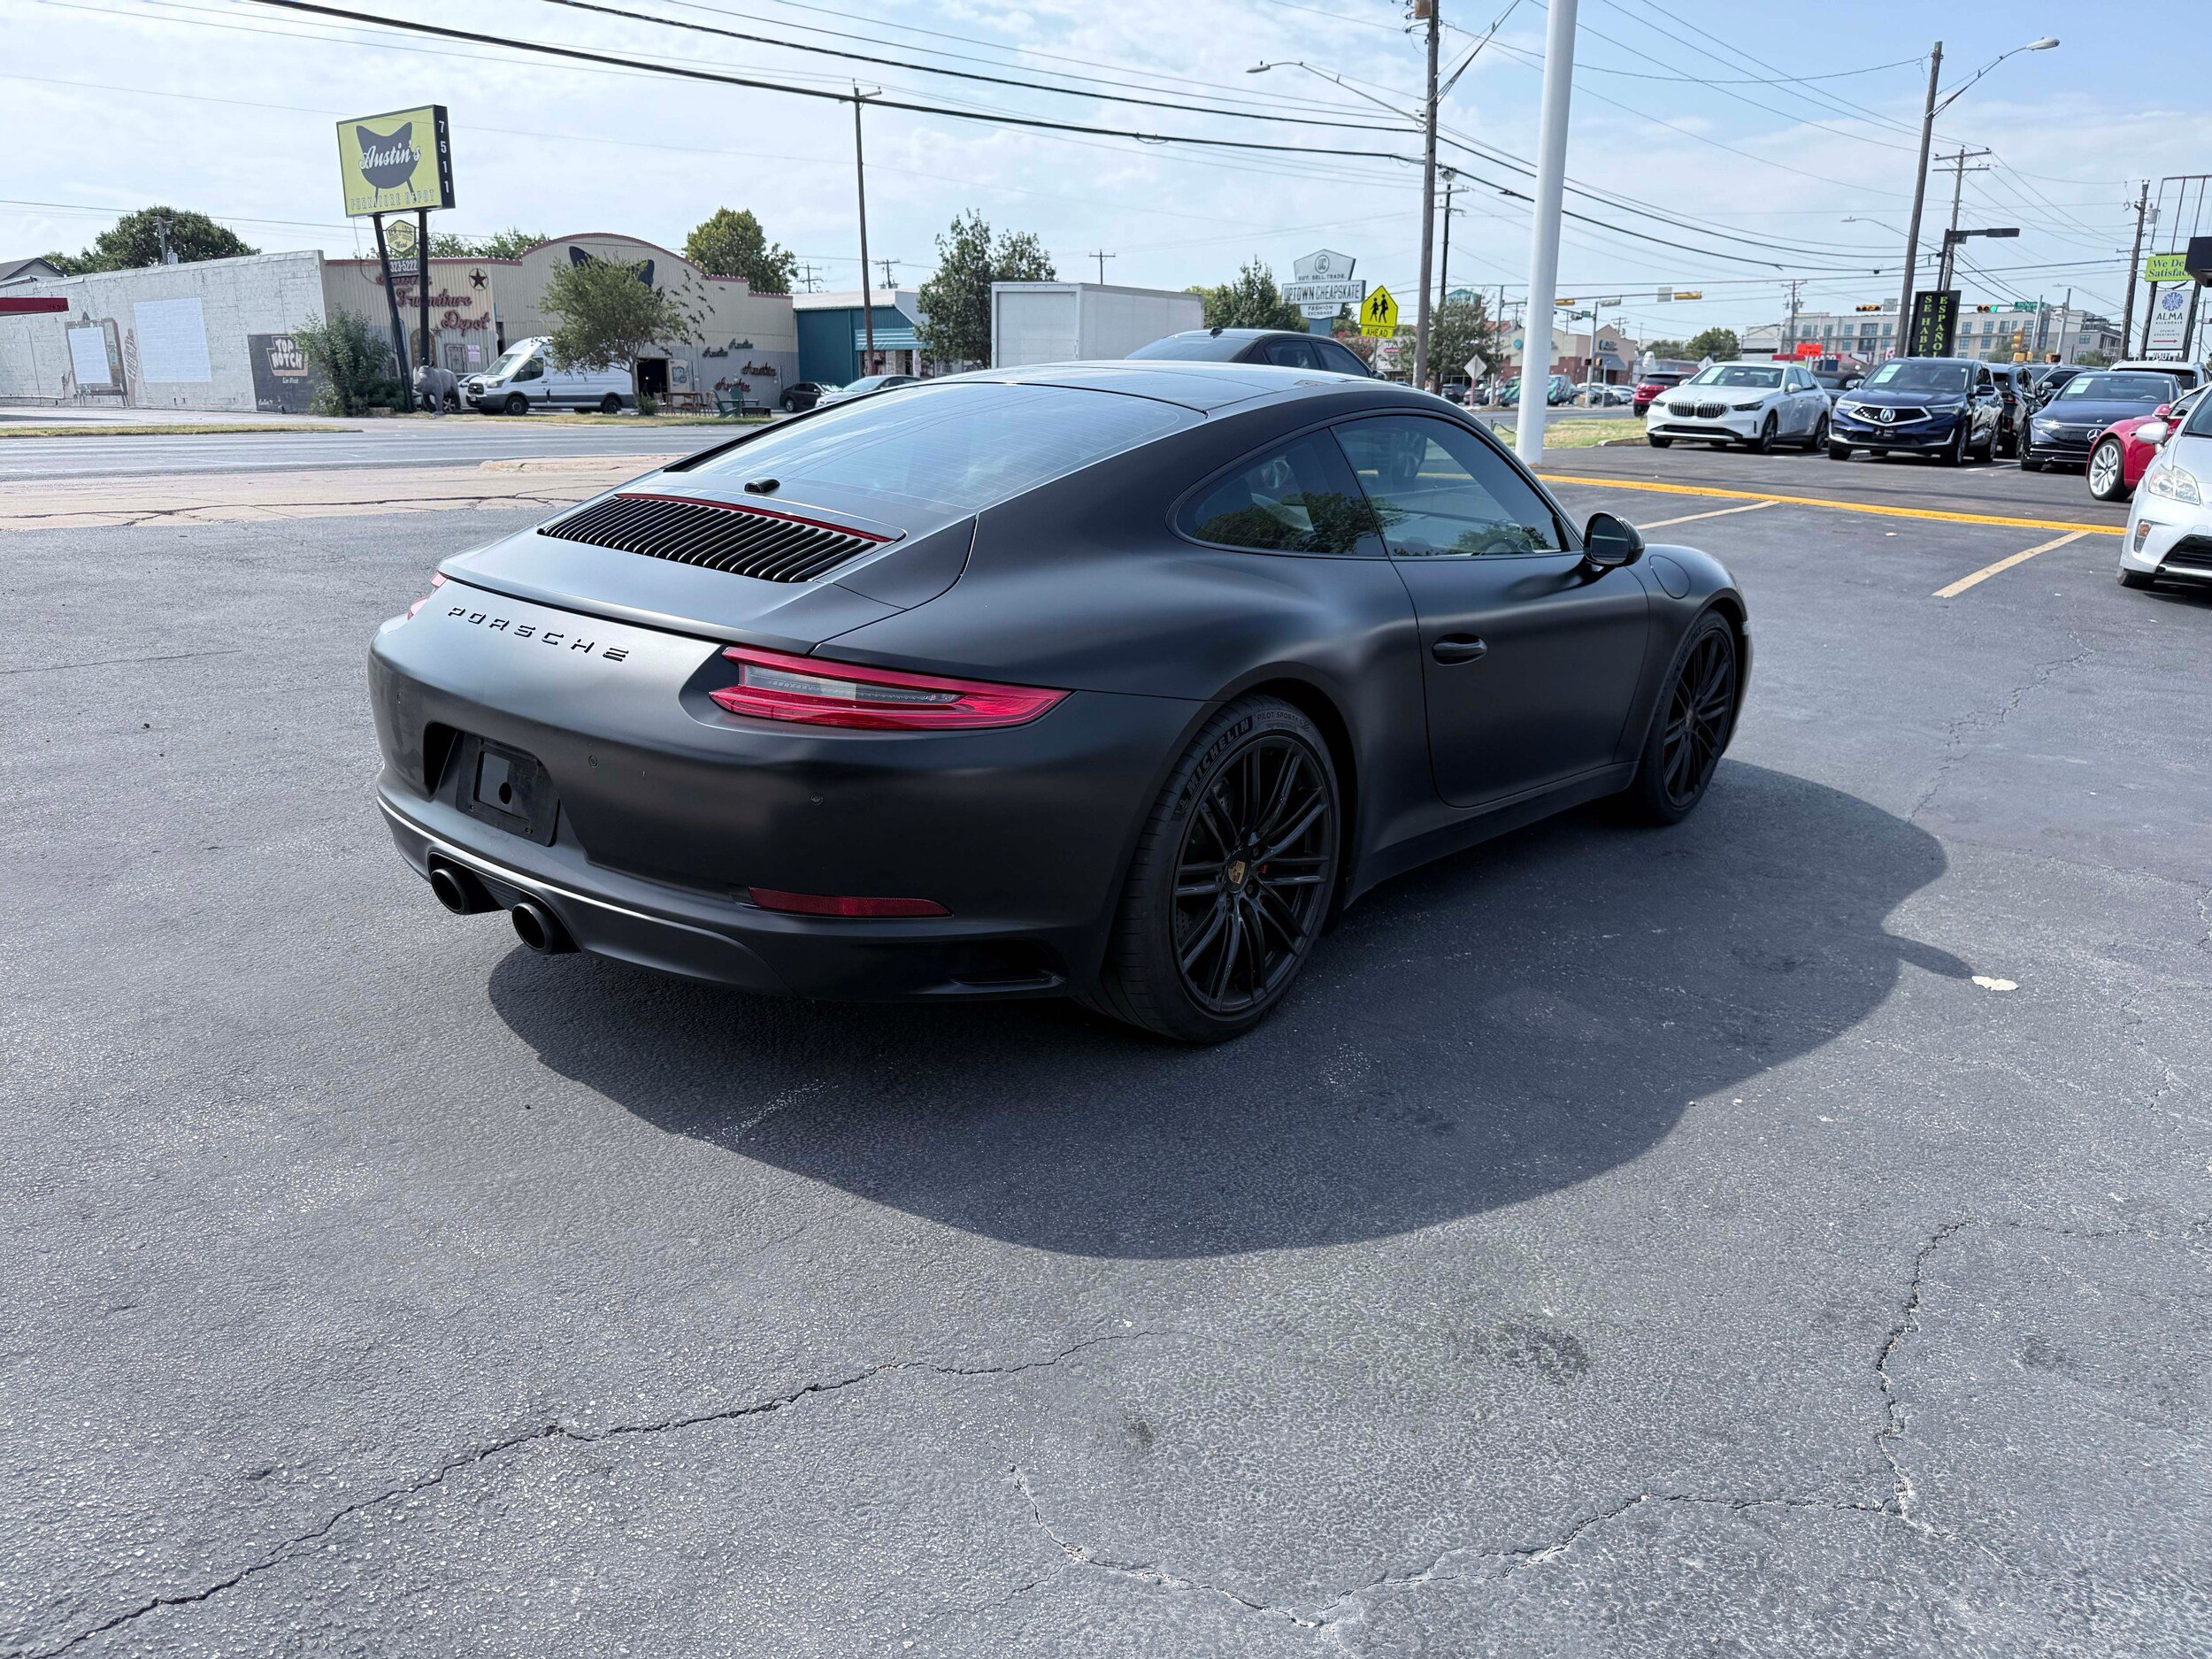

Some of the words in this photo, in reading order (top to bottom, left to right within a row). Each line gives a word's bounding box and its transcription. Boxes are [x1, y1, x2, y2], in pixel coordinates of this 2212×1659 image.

[358, 140, 421, 170] Austin's
[438, 120, 450, 193] 7511
[404, 188, 435, 204] DEPOT
[2148, 268, 2190, 277] Satisfac
[2153, 259, 2168, 268] We
[396, 288, 472, 308] Funiture
[1284, 286, 1315, 302] UPTOWN
[1316, 284, 1360, 300] CHEAPSKATE
[1924, 296, 1932, 312] SE
[442, 310, 491, 337] Depot
[1366, 329, 1388, 338] AHEAD
[274, 338, 294, 353] TOP
[271, 351, 303, 369] NOTCH
[448, 607, 629, 662] PORSCHE
[1257, 711, 1274, 720] PILOT
[1187, 719, 1250, 795] MICHELIN
